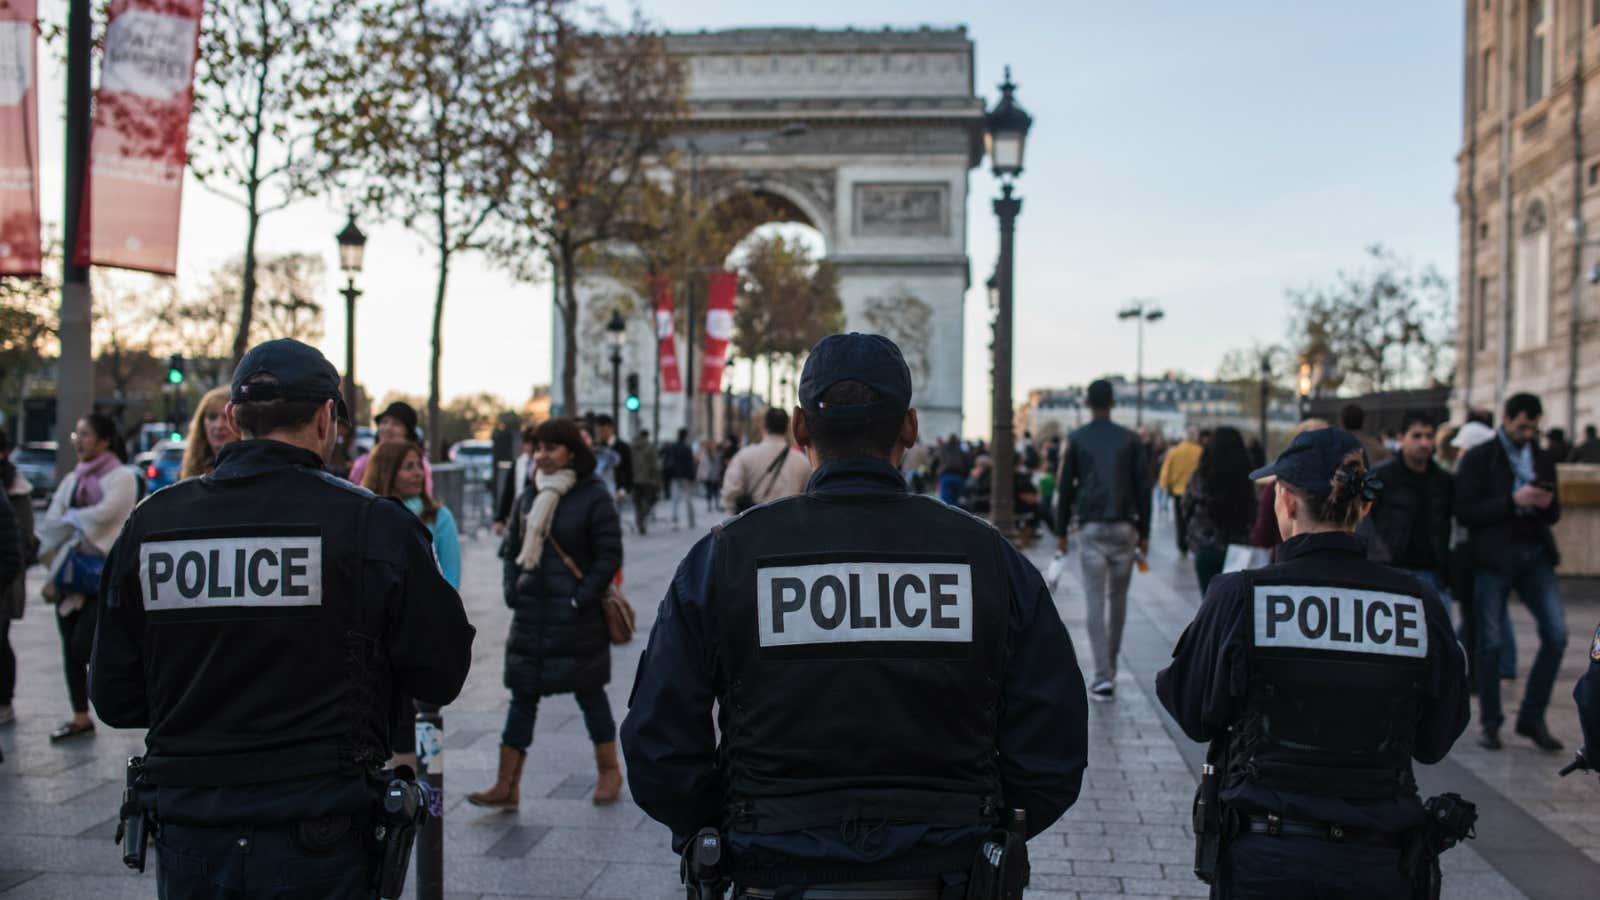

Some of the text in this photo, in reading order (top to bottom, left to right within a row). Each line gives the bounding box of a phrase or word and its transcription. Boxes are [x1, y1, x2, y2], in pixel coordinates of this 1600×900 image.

[148, 548, 309, 601] POLICE
[771, 573, 960, 633] POLICE
[1266, 595, 1419, 648] POLICE
